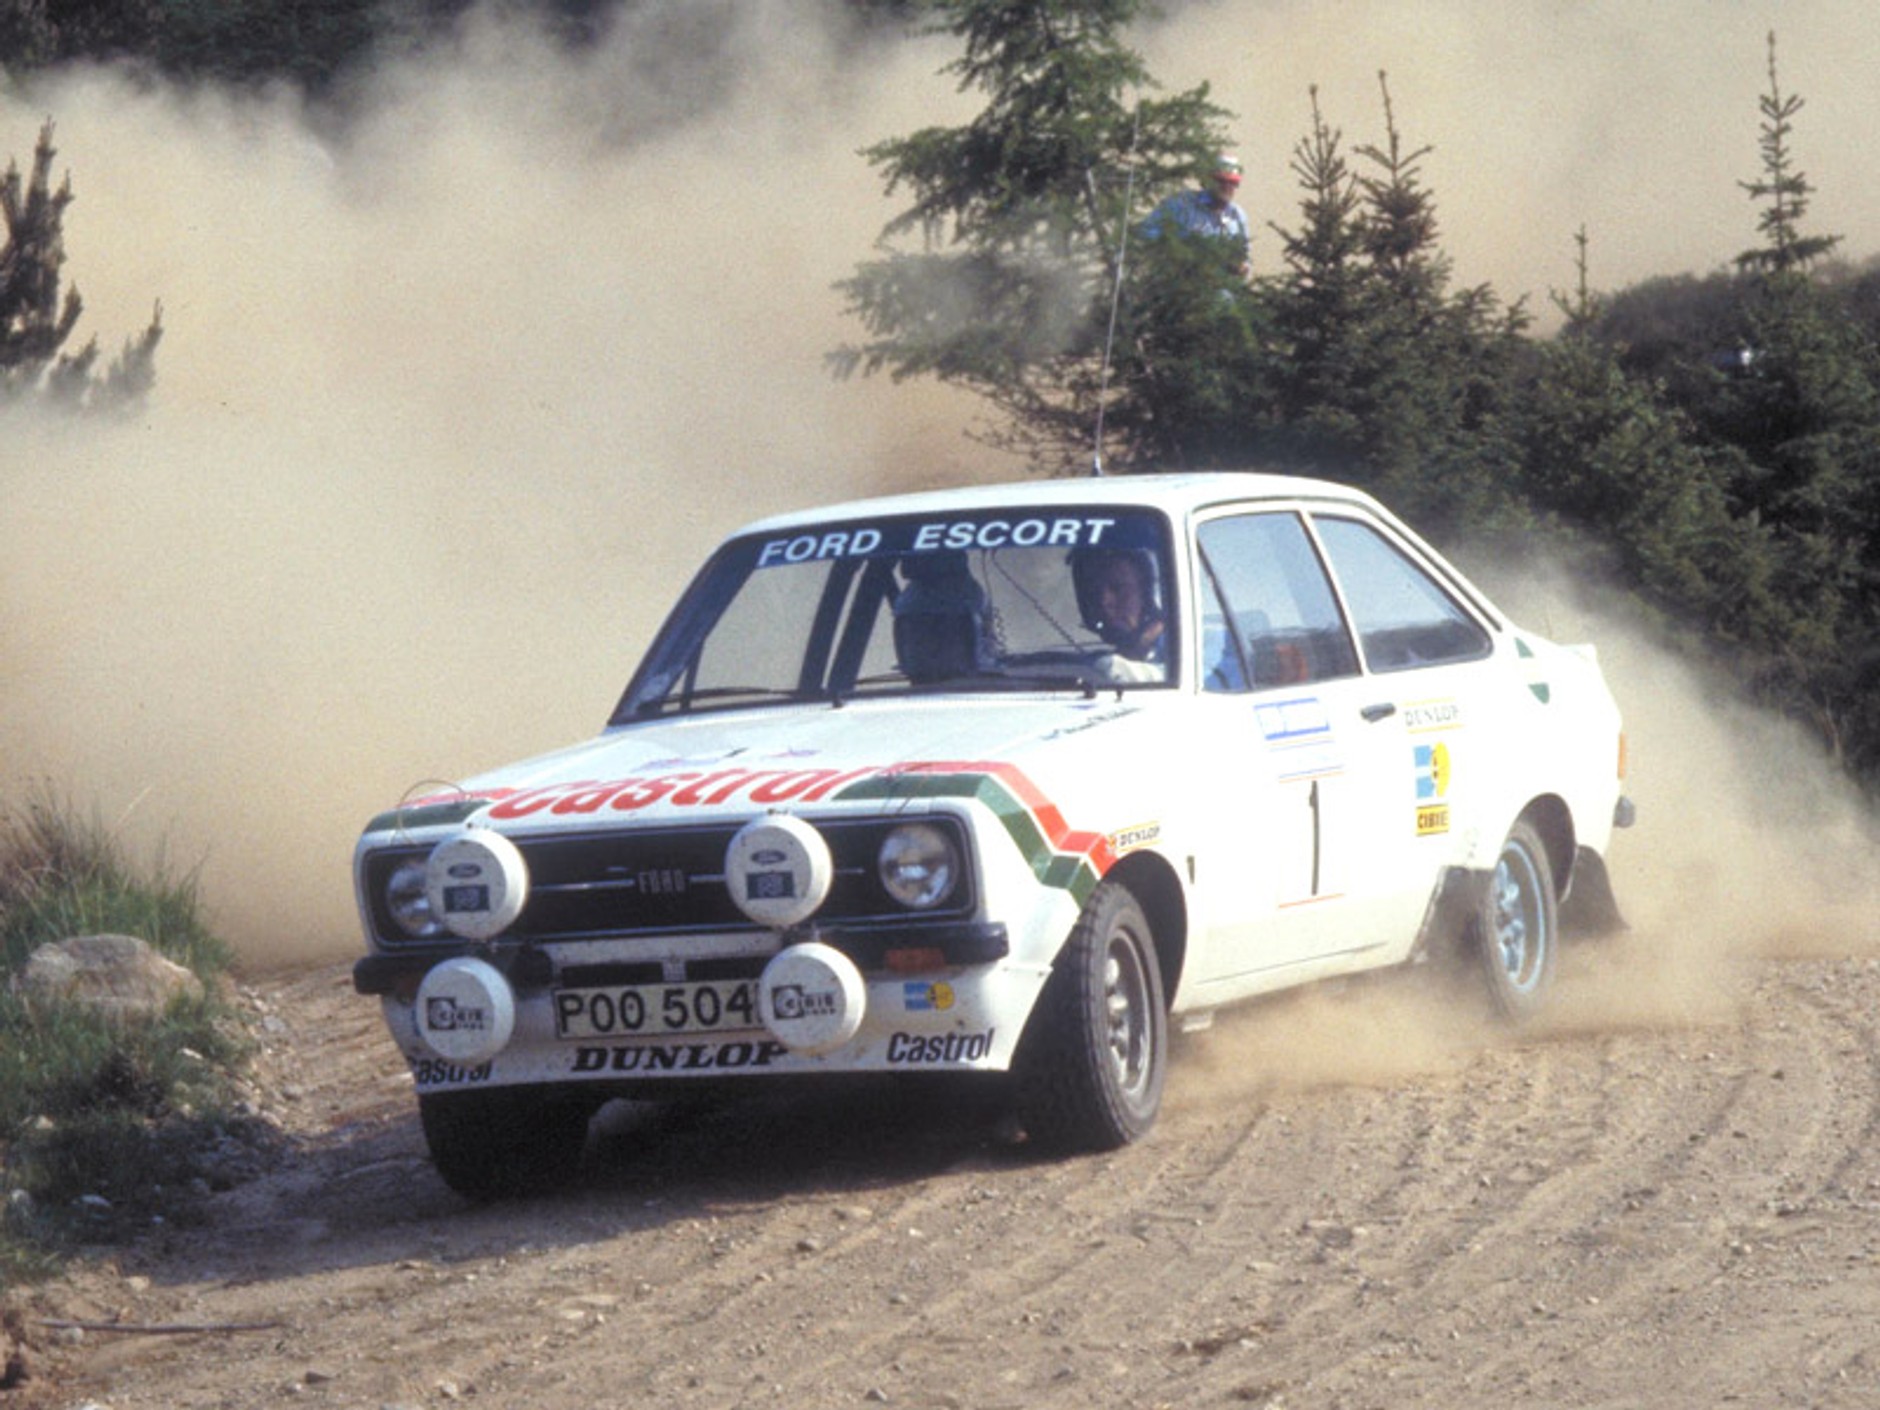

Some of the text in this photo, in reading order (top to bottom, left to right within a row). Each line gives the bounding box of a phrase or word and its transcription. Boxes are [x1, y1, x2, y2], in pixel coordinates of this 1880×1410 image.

[757, 518, 1115, 569] FORD ESCORT
[1404, 705, 1459, 727] DUNLOP
[1417, 809, 1449, 830] CIBIE
[1119, 825, 1160, 848] DUNLOP
[1308, 779, 1320, 896] 1
[637, 869, 686, 894] FORD
[570, 1040, 789, 1072] DUNLOP
[886, 1026, 995, 1063] Castrol
